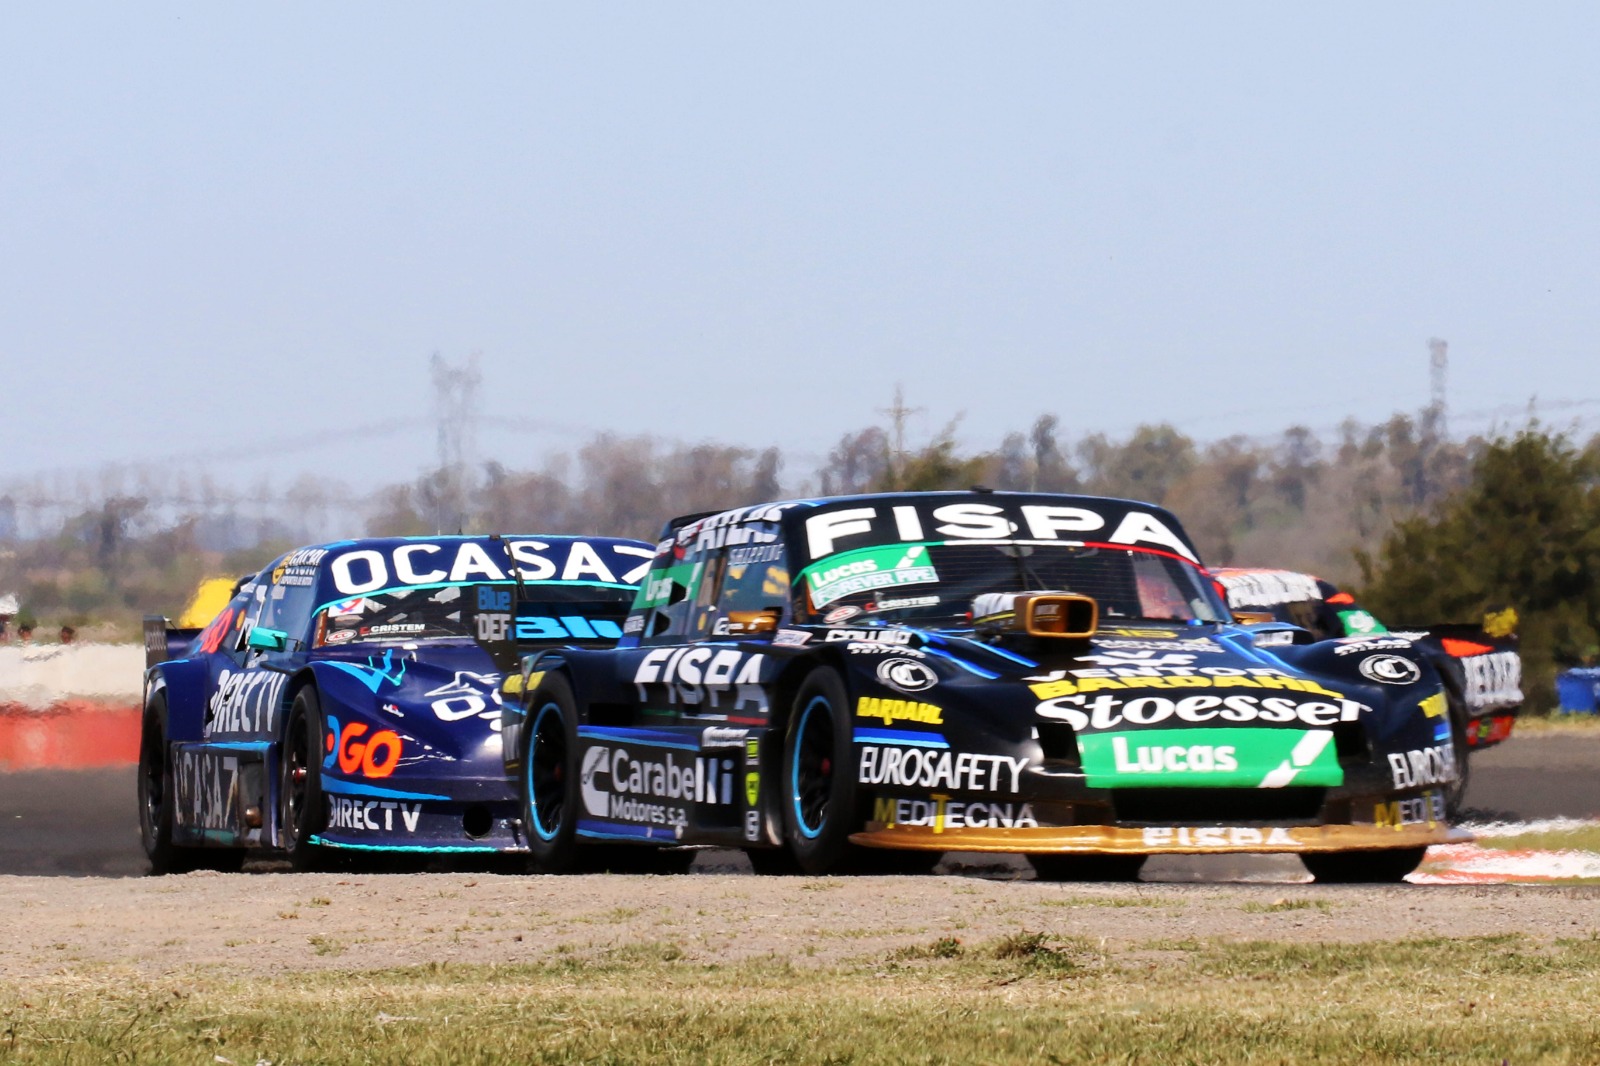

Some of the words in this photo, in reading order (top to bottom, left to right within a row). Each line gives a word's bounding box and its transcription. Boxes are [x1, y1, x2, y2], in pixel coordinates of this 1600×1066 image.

[805, 503, 1200, 565] FISPA
[811, 559, 878, 588] Lucas
[477, 586, 511, 611] Blue
[370, 623, 426, 633] CRISTEM
[477, 613, 512, 641] DEF
[634, 648, 769, 713] FISPA
[1028, 675, 1346, 700] BARDAHL
[856, 696, 944, 726] BARDAHL
[1032, 694, 1374, 733] Stoesser
[858, 746, 1030, 794] EUROSAFETY
[1112, 736, 1239, 773] Lucas
[612, 748, 734, 805] Carabelli
[610, 794, 666, 825] Motores
[873, 793, 1040, 834] MEDITECNA
